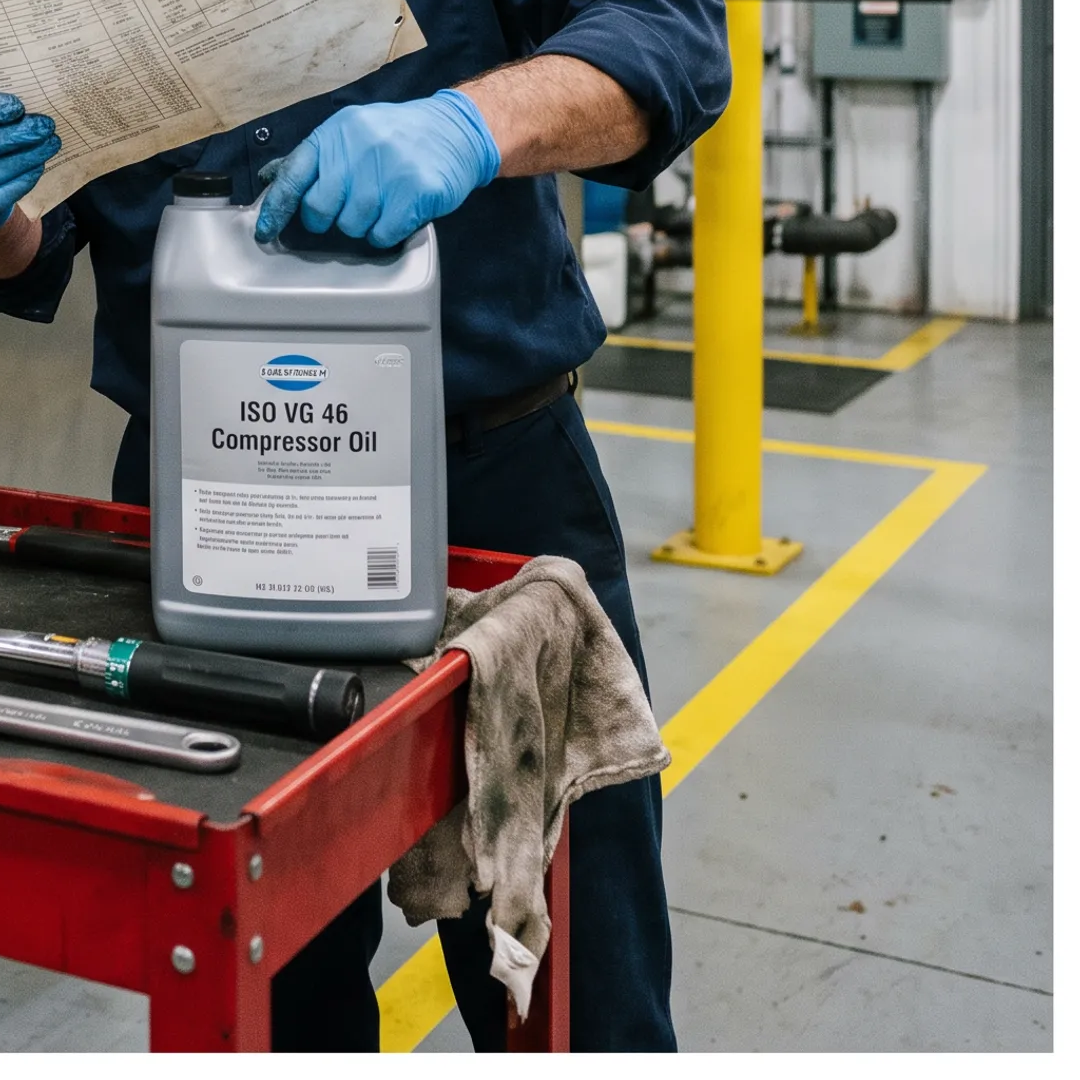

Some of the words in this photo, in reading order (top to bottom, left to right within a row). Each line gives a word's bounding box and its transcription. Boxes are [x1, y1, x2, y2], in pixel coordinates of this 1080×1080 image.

[240, 401, 277, 423] ISO
[284, 402, 314, 424] VG
[322, 403, 348, 424] 46
[211, 427, 341, 456] Compressor
[349, 430, 377, 453] Oil
